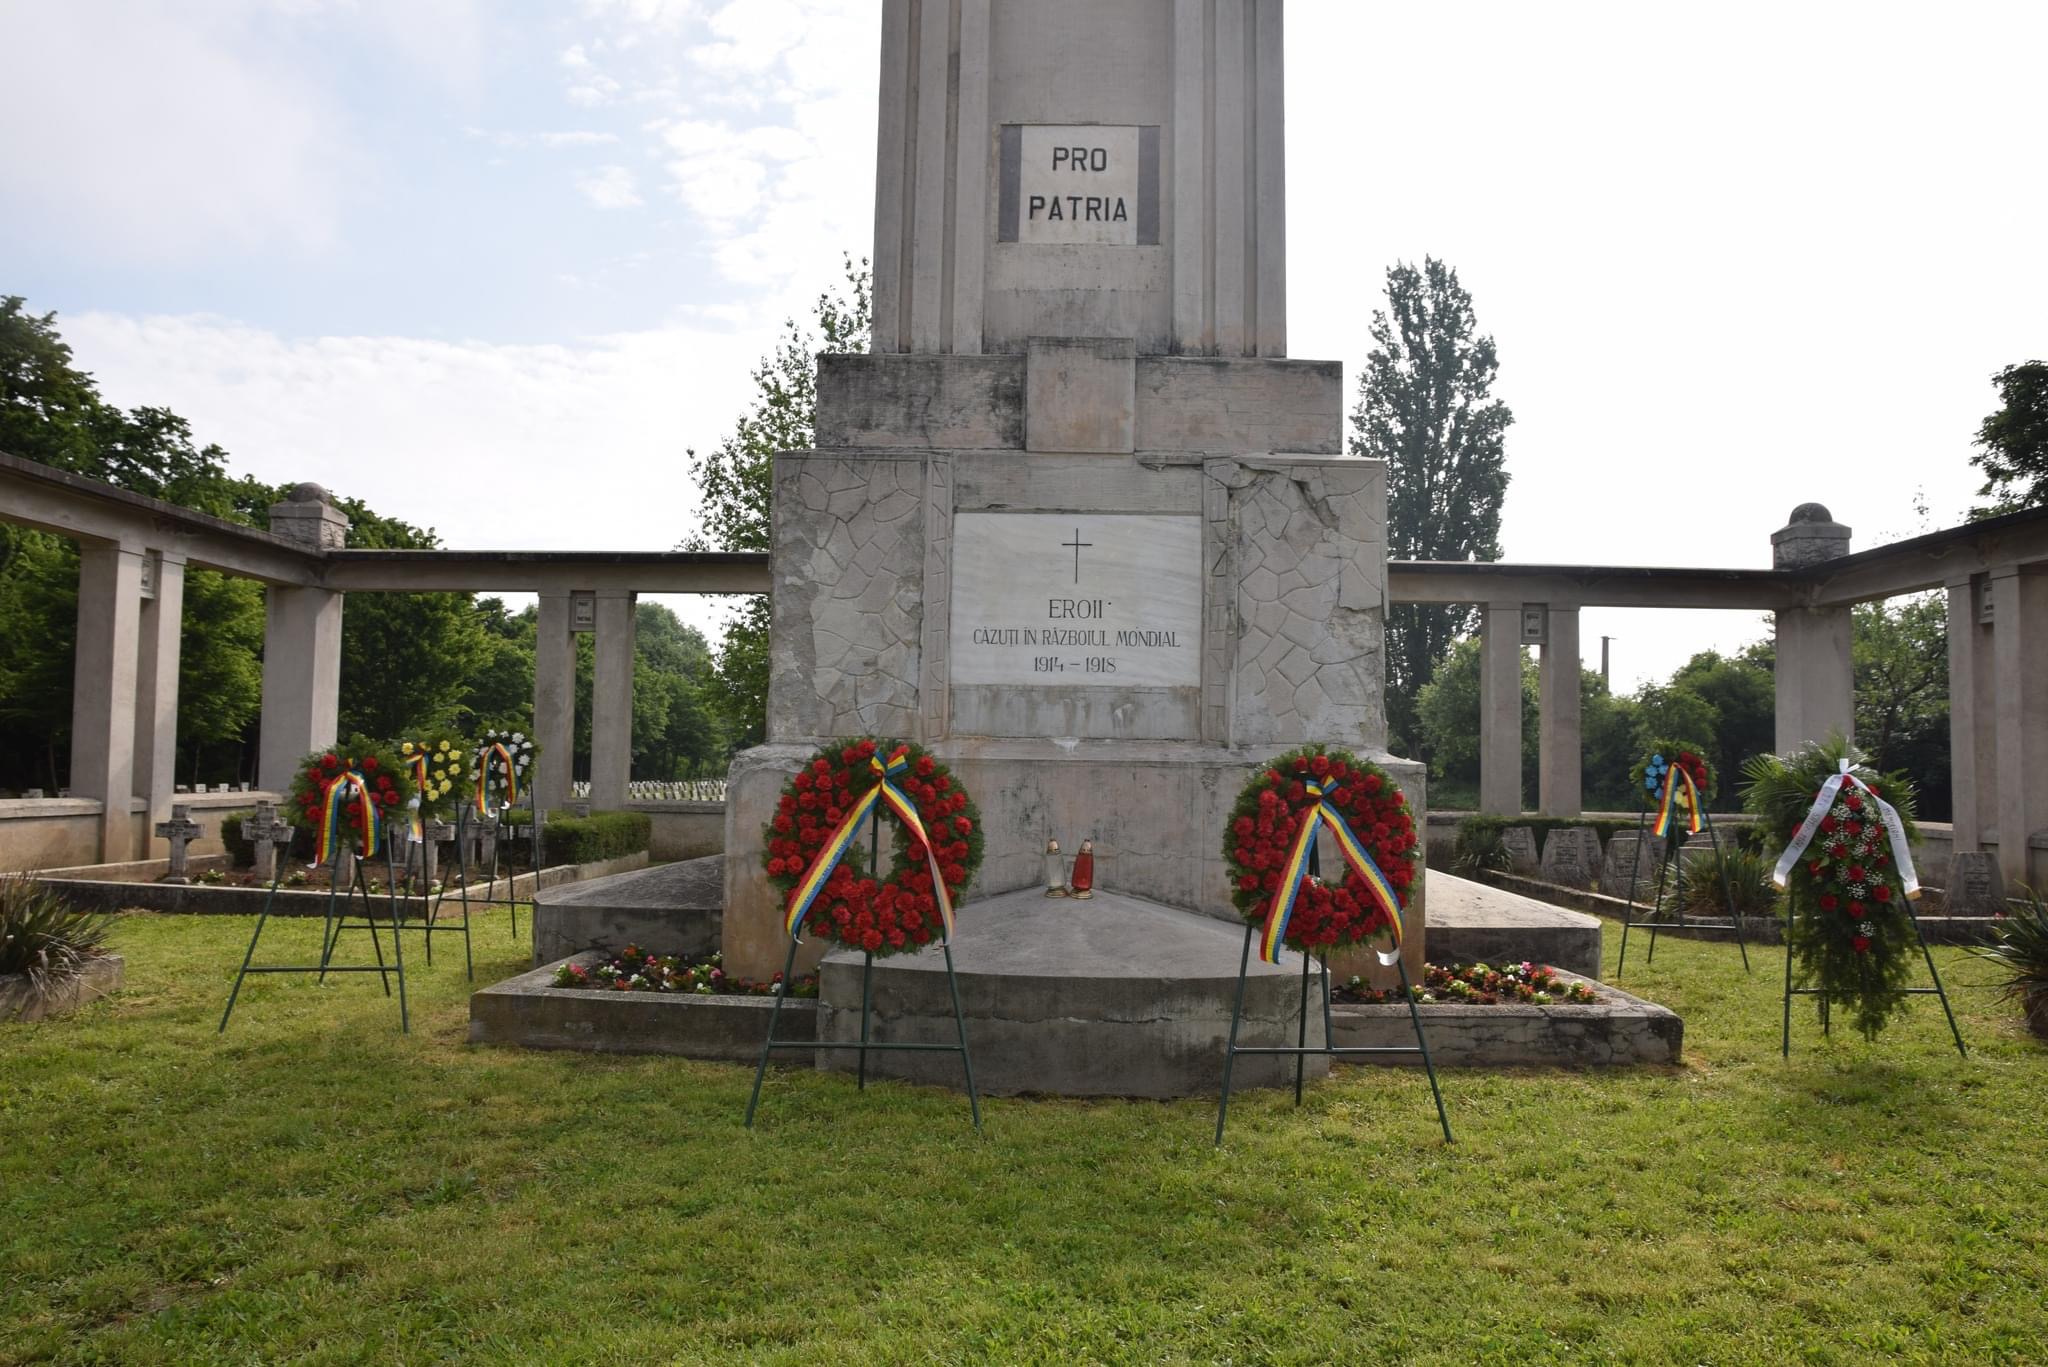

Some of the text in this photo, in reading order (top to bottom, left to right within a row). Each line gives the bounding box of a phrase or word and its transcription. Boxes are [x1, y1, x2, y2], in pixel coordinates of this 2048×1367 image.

[1052, 147, 1107, 172] PRO
[1029, 196, 1128, 221] PATRIA
[1048, 599, 1103, 619] EROII
[1115, 630, 1181, 648] MONDIAL
[1034, 657, 1064, 673] 1914
[1086, 657, 1117, 673] 1918
